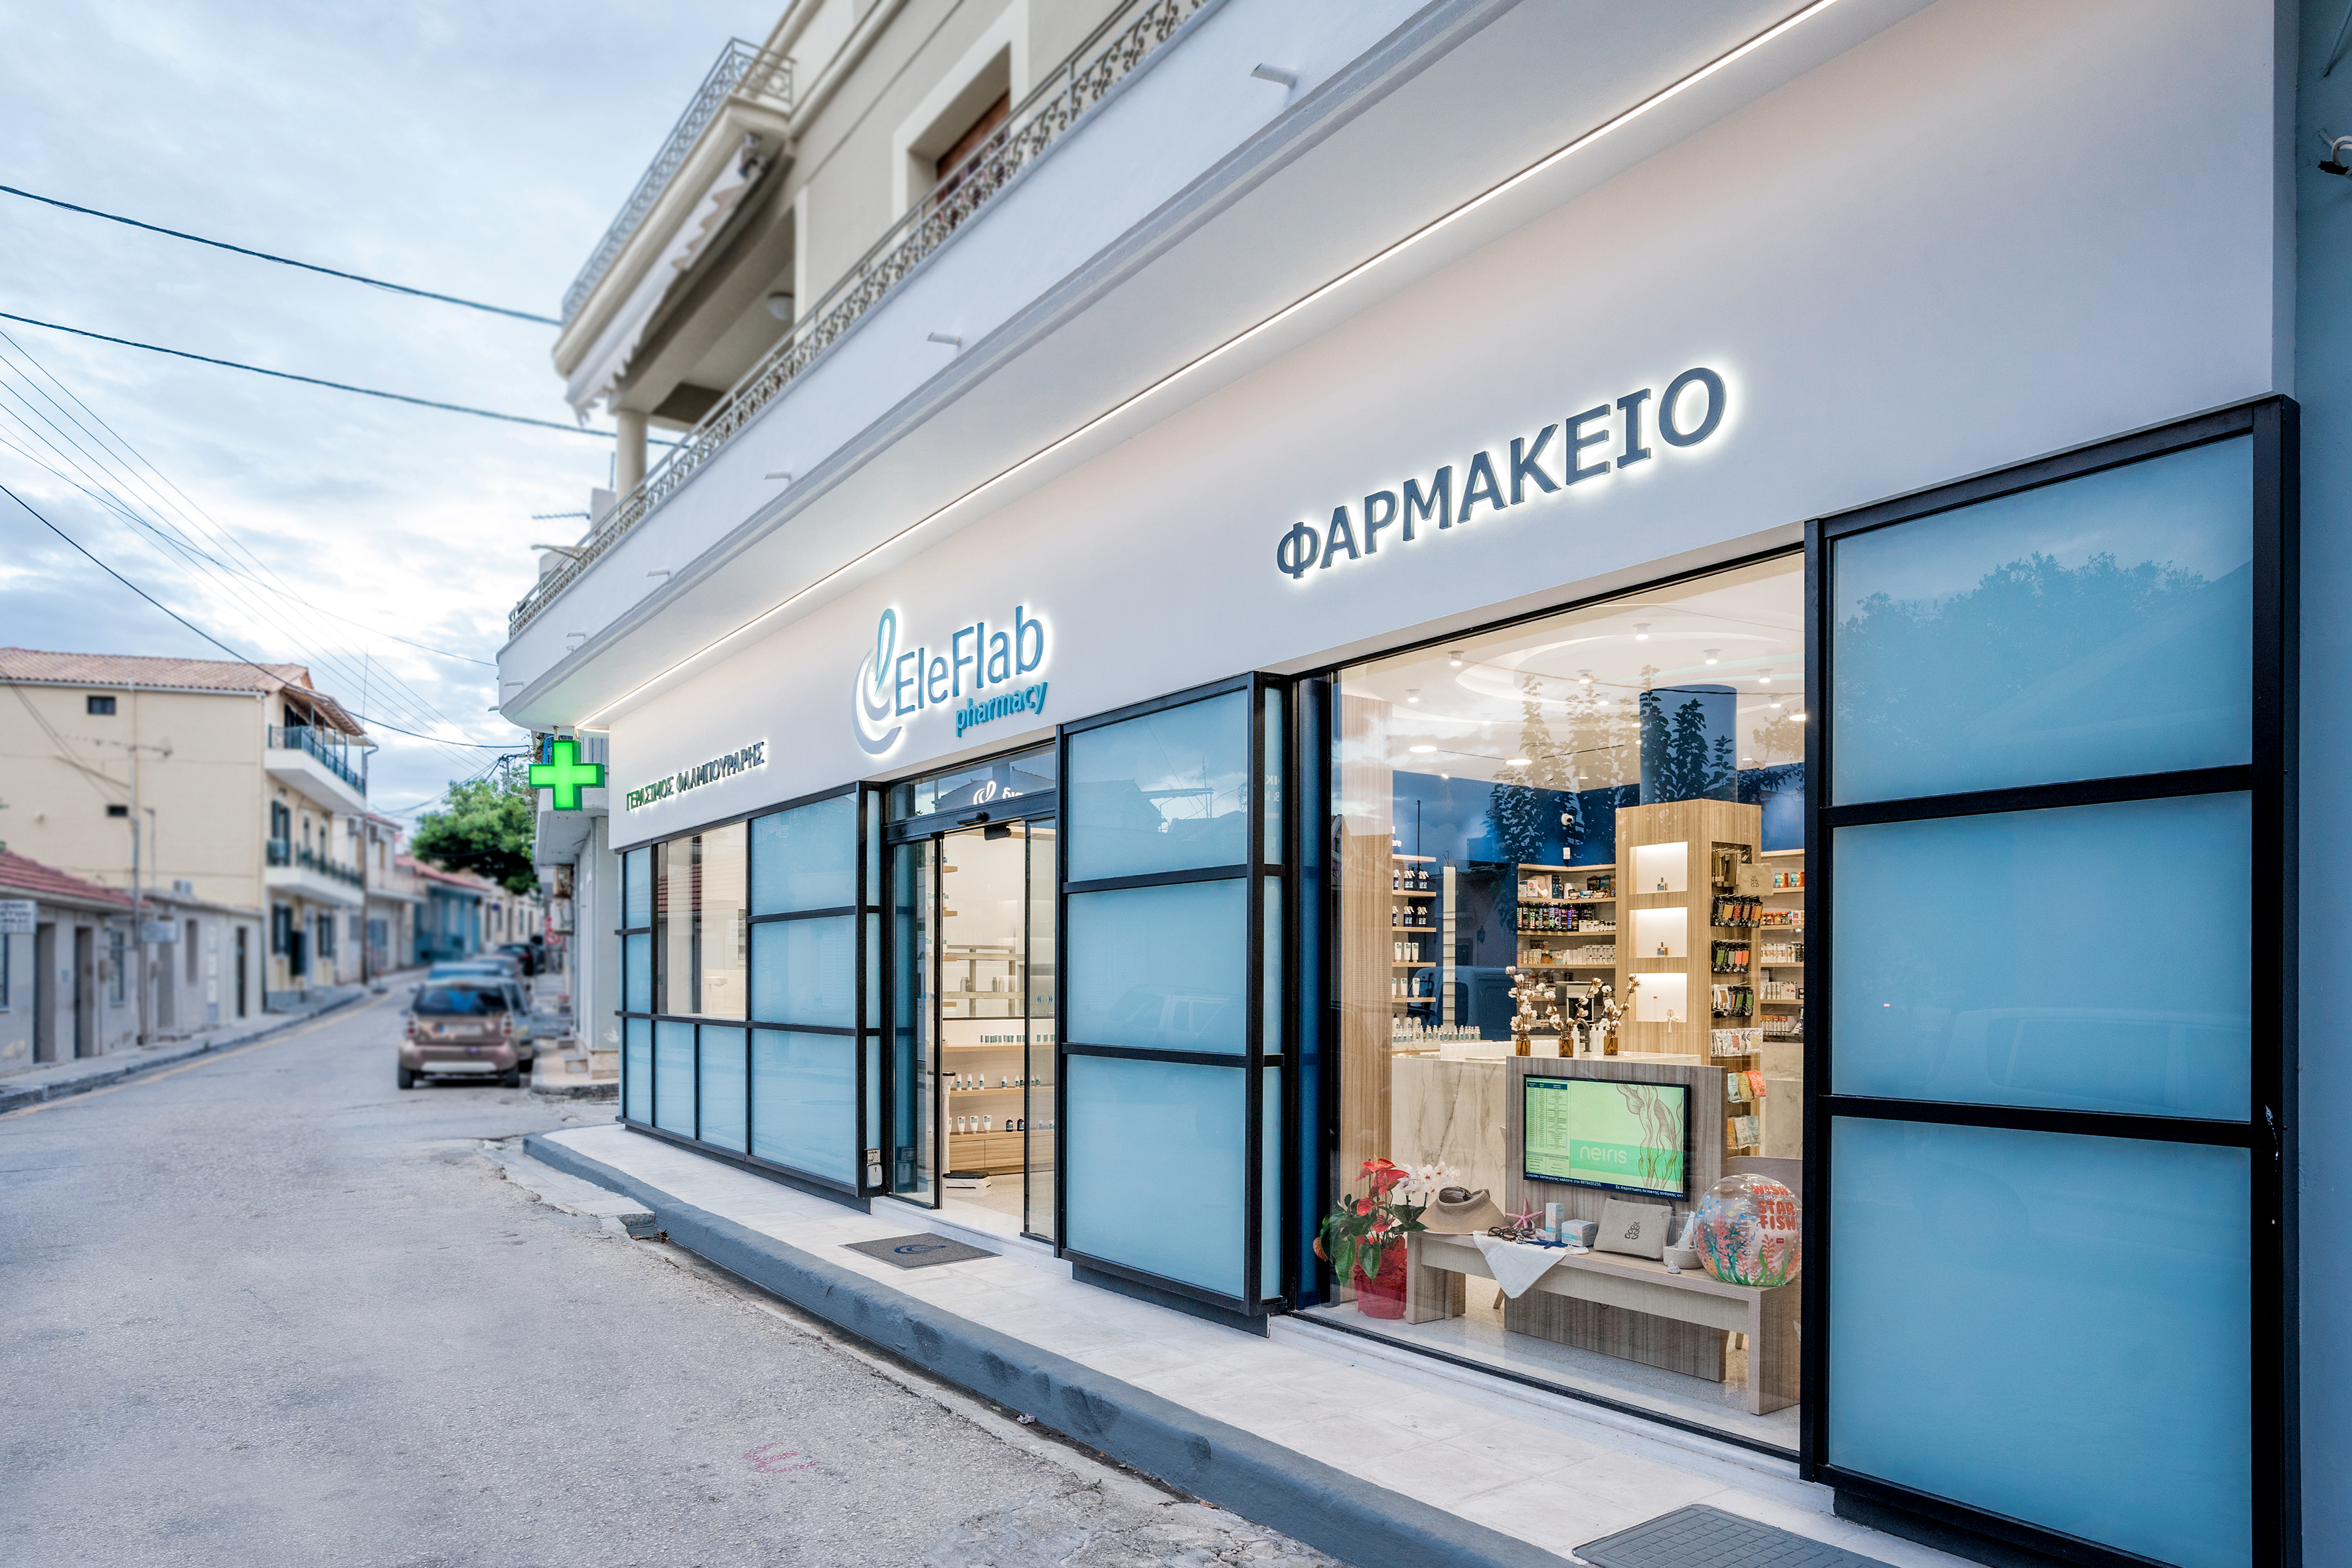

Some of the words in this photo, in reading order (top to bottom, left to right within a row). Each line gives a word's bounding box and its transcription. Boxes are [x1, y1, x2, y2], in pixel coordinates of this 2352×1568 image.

[1276, 367, 1727, 580] ΦΑΡΜΑΚΕΙΟ
[896, 605, 1044, 716] EleFlab
[956, 682, 1048, 737] pharmacy
[626, 775, 674, 811] ΓΕΡΑΣΙΜΟΣ
[676, 741, 765, 793] ΦΛΑΜΠΟΥΡΑΡΗΣ
[1580, 1146, 1627, 1164] neiris
[1751, 1184, 1789, 1196] WISH
[1757, 1200, 1796, 1215] STAR
[1760, 1215, 1796, 1231] FISH
